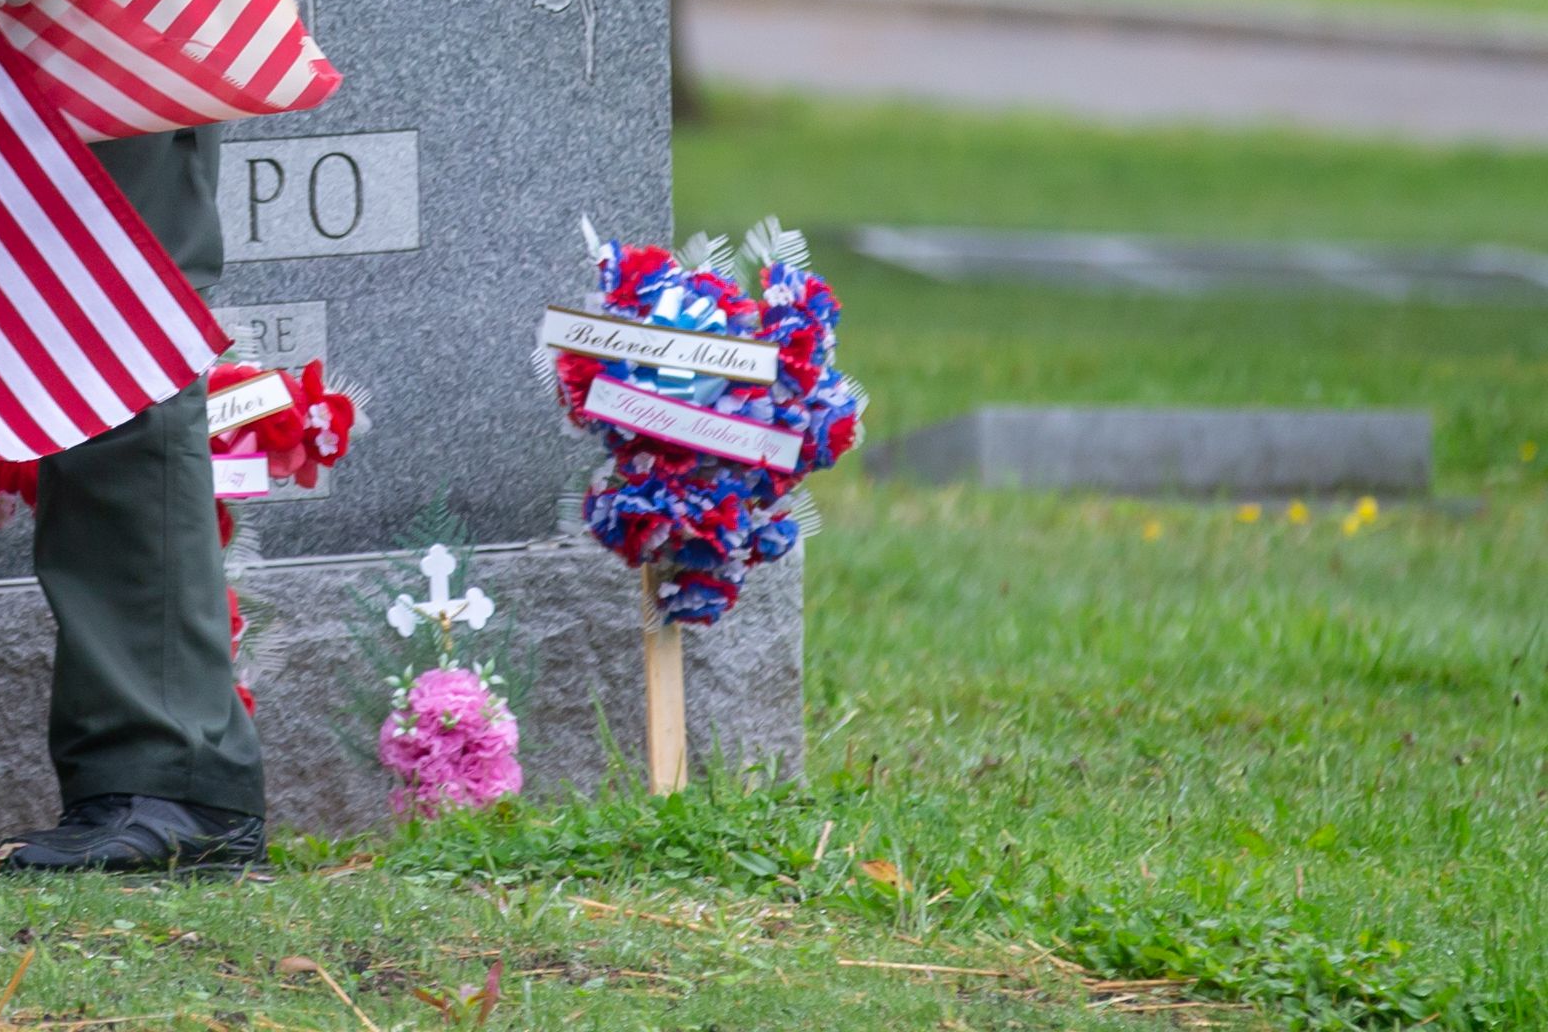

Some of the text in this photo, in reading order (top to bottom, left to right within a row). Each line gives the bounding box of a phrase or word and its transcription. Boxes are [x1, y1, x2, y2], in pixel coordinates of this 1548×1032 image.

[564, 322, 758, 373] Beloved Mother
[609, 391, 679, 433] Happy
[680, 414, 750, 448] Mother's
